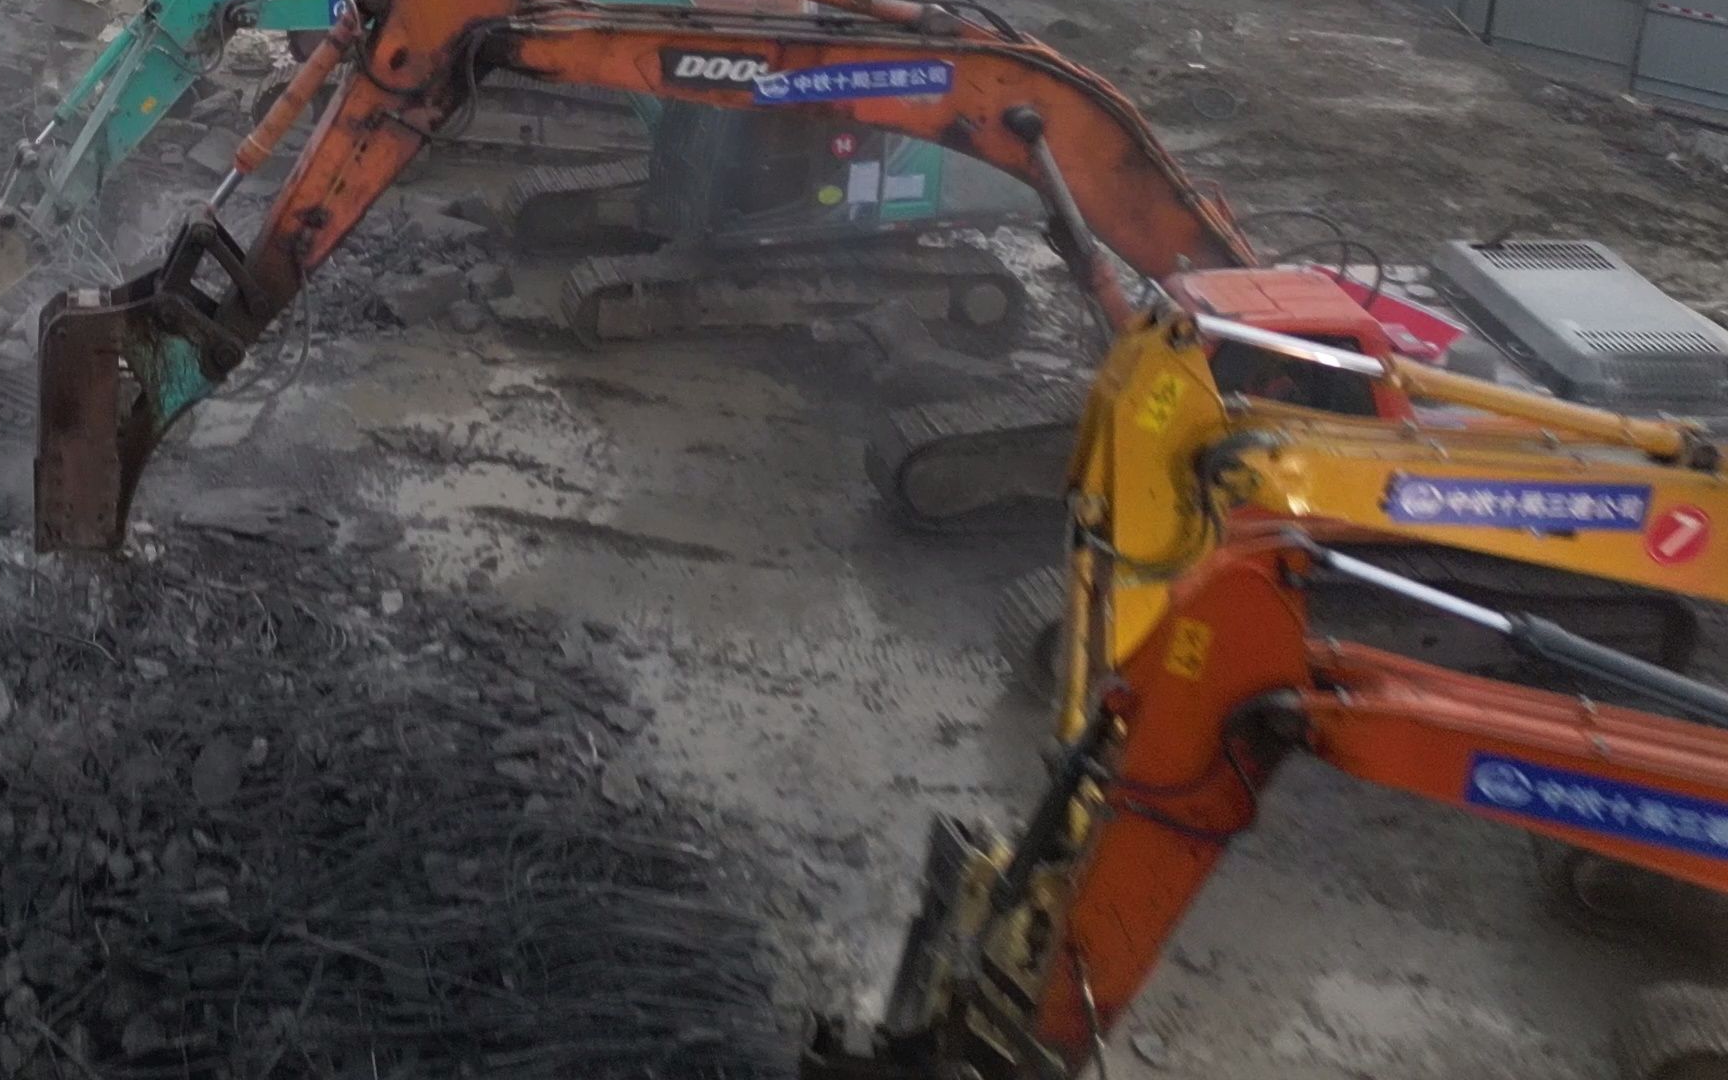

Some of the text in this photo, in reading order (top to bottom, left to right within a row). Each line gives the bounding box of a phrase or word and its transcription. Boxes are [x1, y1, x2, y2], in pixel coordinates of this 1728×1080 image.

[793, 65, 947, 94] 中铁十局三建公司
[1445, 487, 1644, 522] 中铁十局三建公司
[1659, 510, 1705, 558] 7
